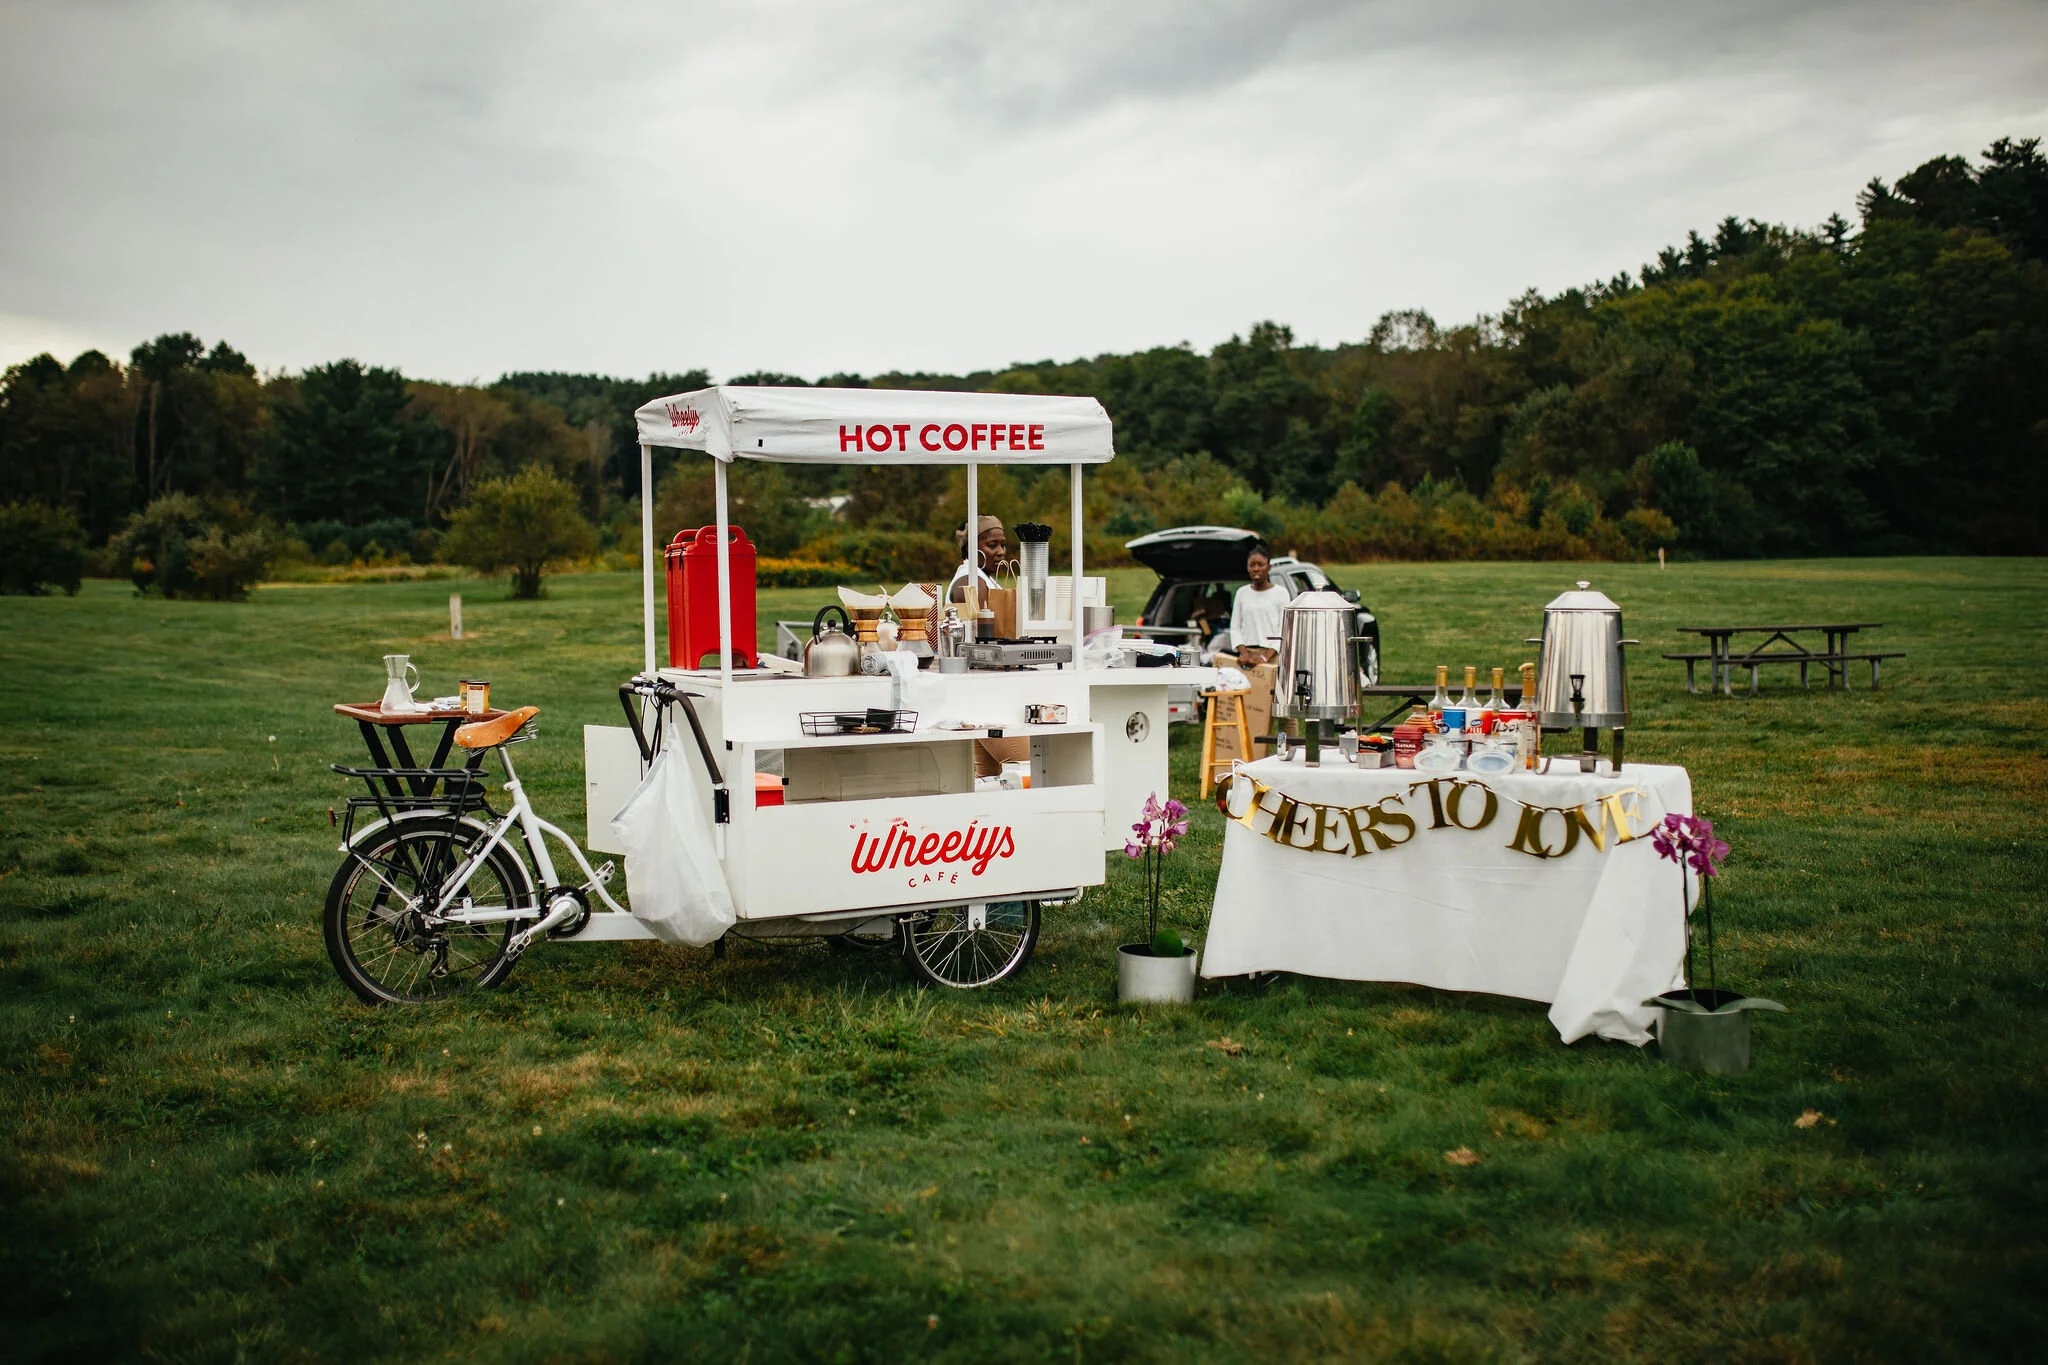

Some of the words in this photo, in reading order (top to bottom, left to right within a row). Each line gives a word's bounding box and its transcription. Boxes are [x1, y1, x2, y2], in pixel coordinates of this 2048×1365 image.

[665, 403, 700, 433] Wheelys
[839, 424, 911, 452] HOT
[919, 424, 1045, 451] COFFEE
[1216, 772, 1416, 858] CHEERS
[1408, 777, 1498, 830] TO
[1505, 785, 1660, 859] LOVE
[850, 820, 1015, 876] Wheelys
[908, 871, 958, 888] CAFÉ
